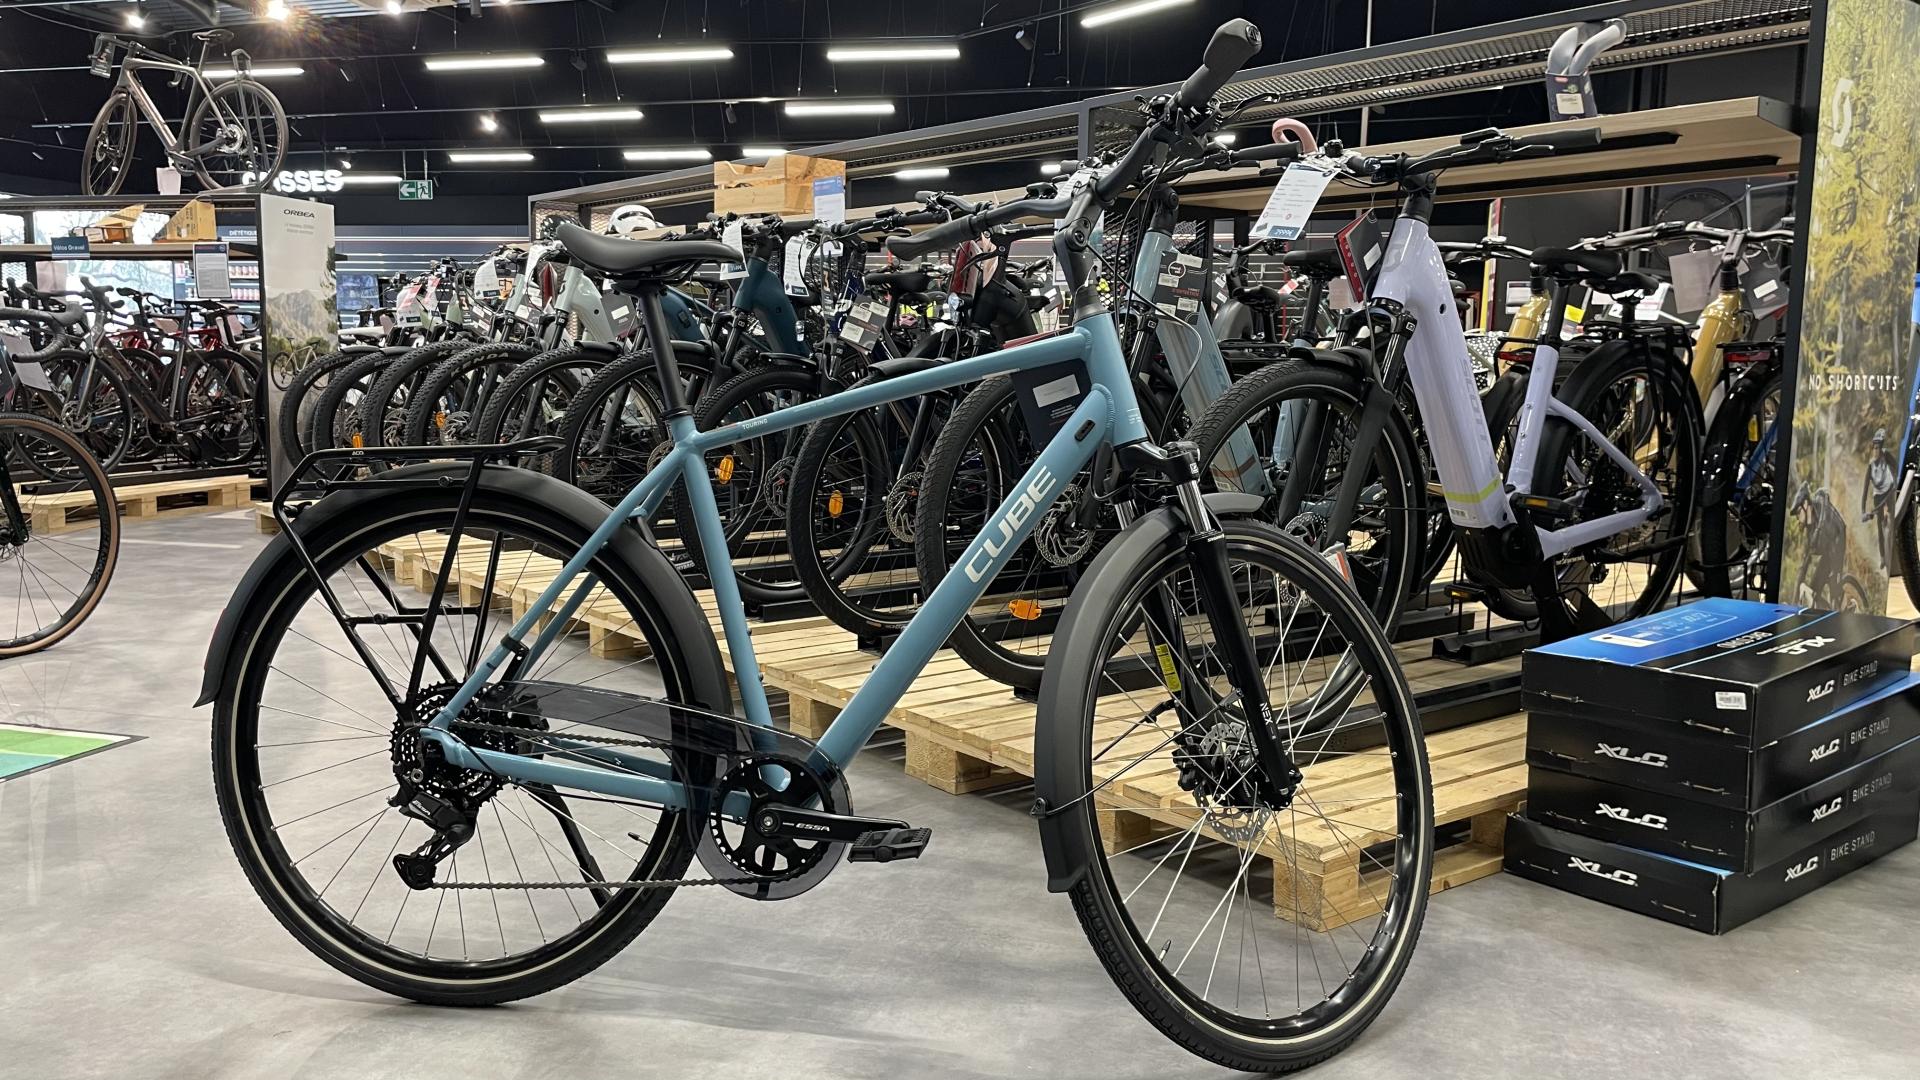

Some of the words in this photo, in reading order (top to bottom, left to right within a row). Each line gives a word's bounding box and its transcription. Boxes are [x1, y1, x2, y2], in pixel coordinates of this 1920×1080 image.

[283, 208, 315, 218] ORBEA
[1808, 374, 1821, 391] NO
[1828, 374, 1898, 391] SHORTCUTS
[742, 418, 768, 430] TOURING
[964, 465, 1057, 583] CUBE
[1806, 679, 1835, 703] XLC
[1843, 668, 1859, 686] BIKE
[1859, 660, 1878, 680] STAND
[1260, 702, 1273, 725] NEX
[1809, 738, 1840, 763] XLC
[1850, 727, 1867, 745] BIKE
[1868, 717, 1890, 736] STAND
[1594, 742, 1668, 767] XLC
[1811, 796, 1842, 823] XLC
[1852, 783, 1869, 802] BIKE
[1870, 772, 1893, 793] STAND
[1595, 802, 1668, 829] XLC
[1784, 856, 1819, 882] XLC
[1830, 840, 1849, 861] BIKE
[1851, 830, 1876, 852] STAND
[1567, 856, 1638, 885] XLC
